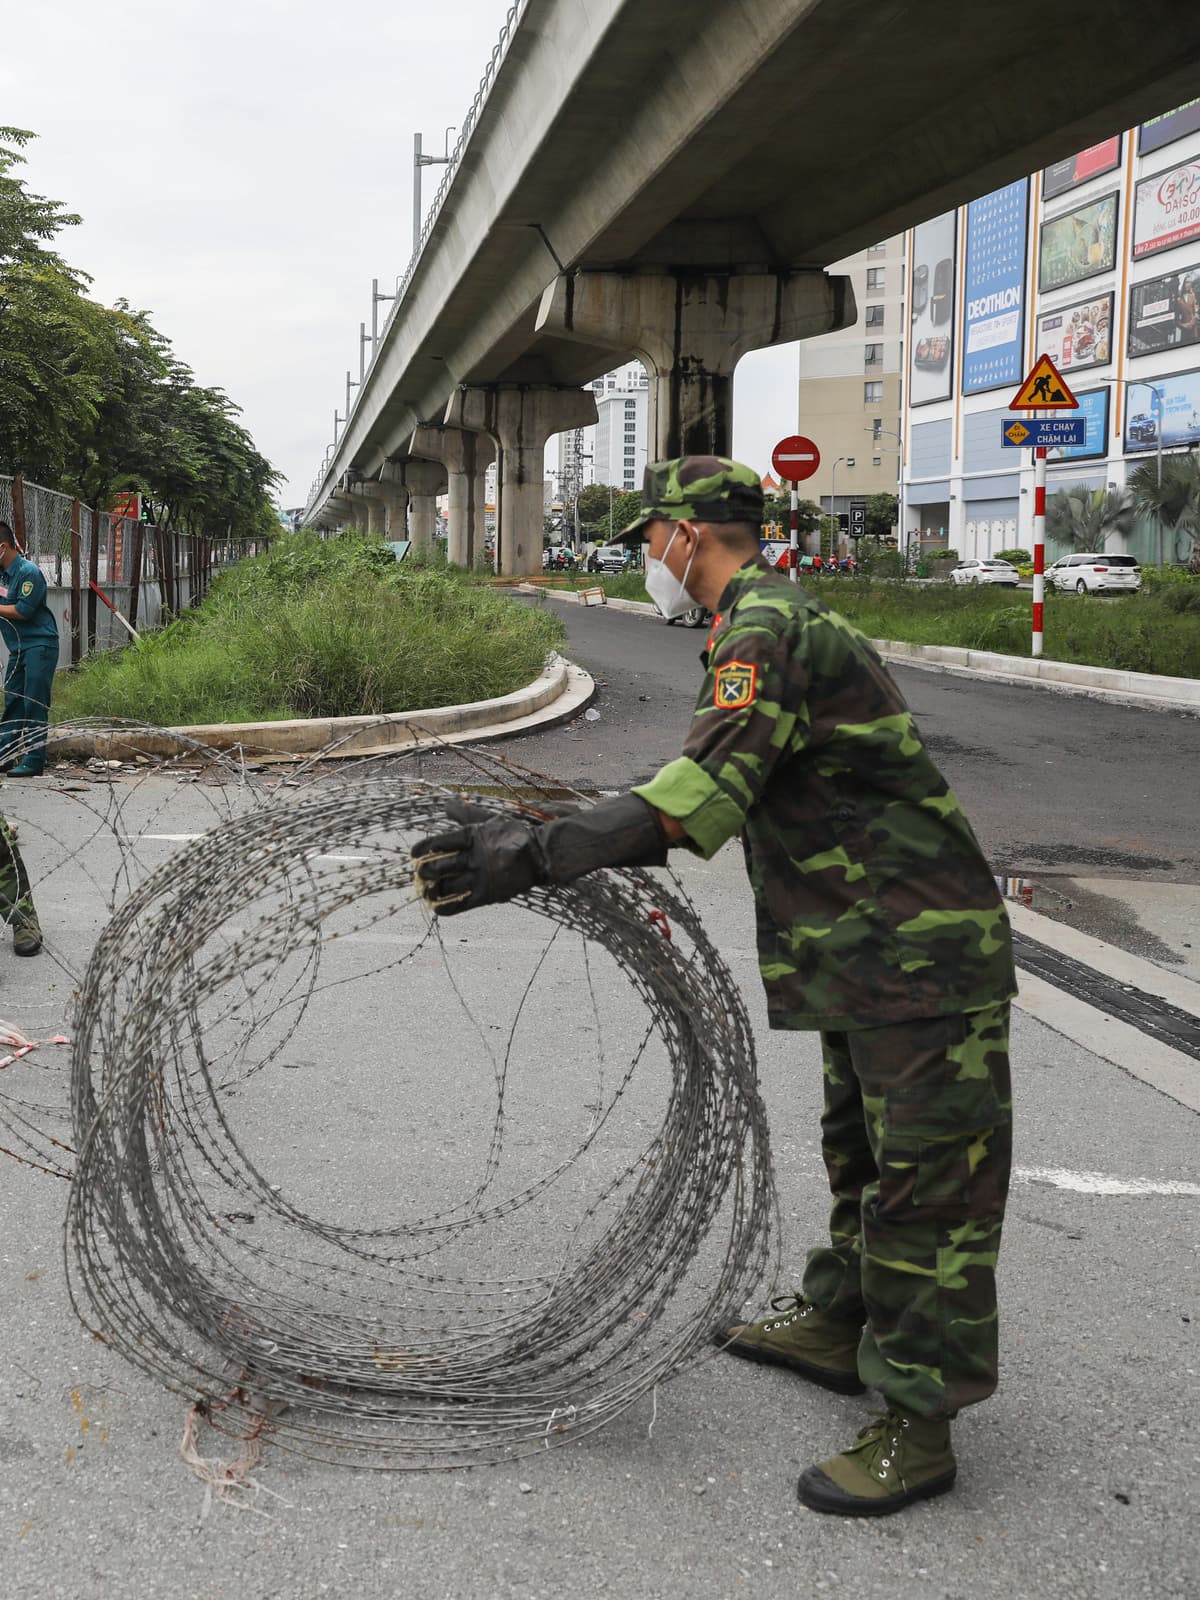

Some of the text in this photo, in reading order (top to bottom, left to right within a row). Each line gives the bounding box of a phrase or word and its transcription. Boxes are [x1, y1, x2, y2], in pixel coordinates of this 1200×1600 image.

[1165, 191, 1197, 214] DAISO
[967, 285, 1021, 321] DECATHLON
[1040, 423, 1051, 432] XE
[854, 511, 862, 521] P
